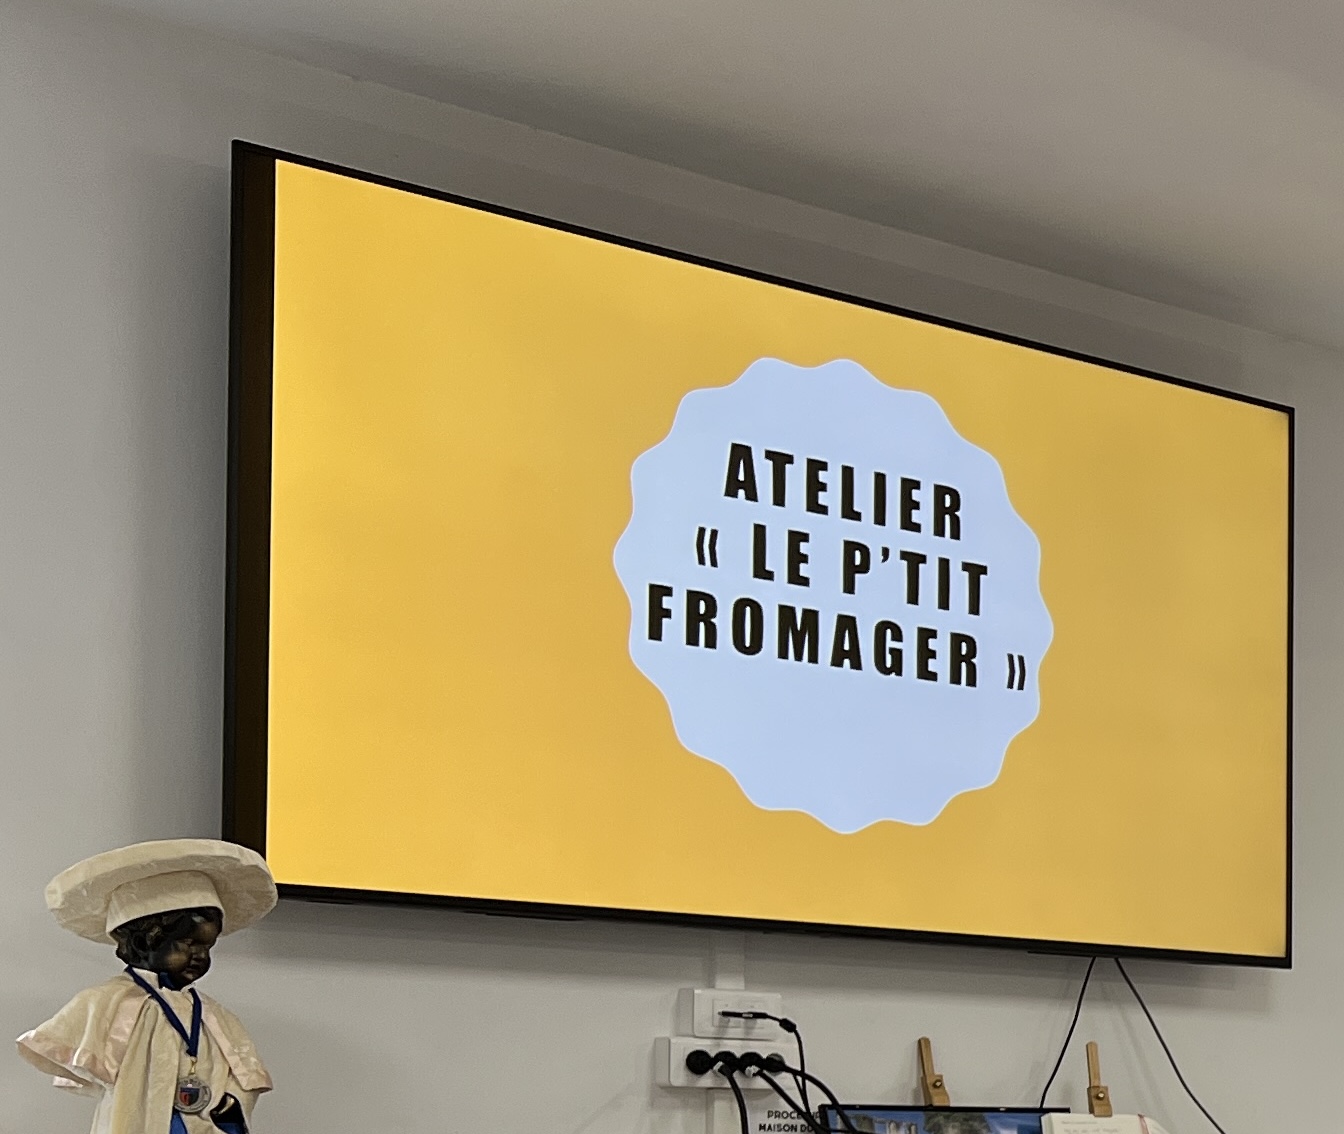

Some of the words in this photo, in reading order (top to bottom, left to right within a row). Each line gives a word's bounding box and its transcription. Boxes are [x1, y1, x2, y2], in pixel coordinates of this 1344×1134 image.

[723, 442, 961, 541] ATELIER
[752, 523, 811, 588] LE
[842, 539, 989, 617] P'TIT
[648, 583, 978, 688] FROMAGER
[758, 1123, 798, 1133] MAISON
